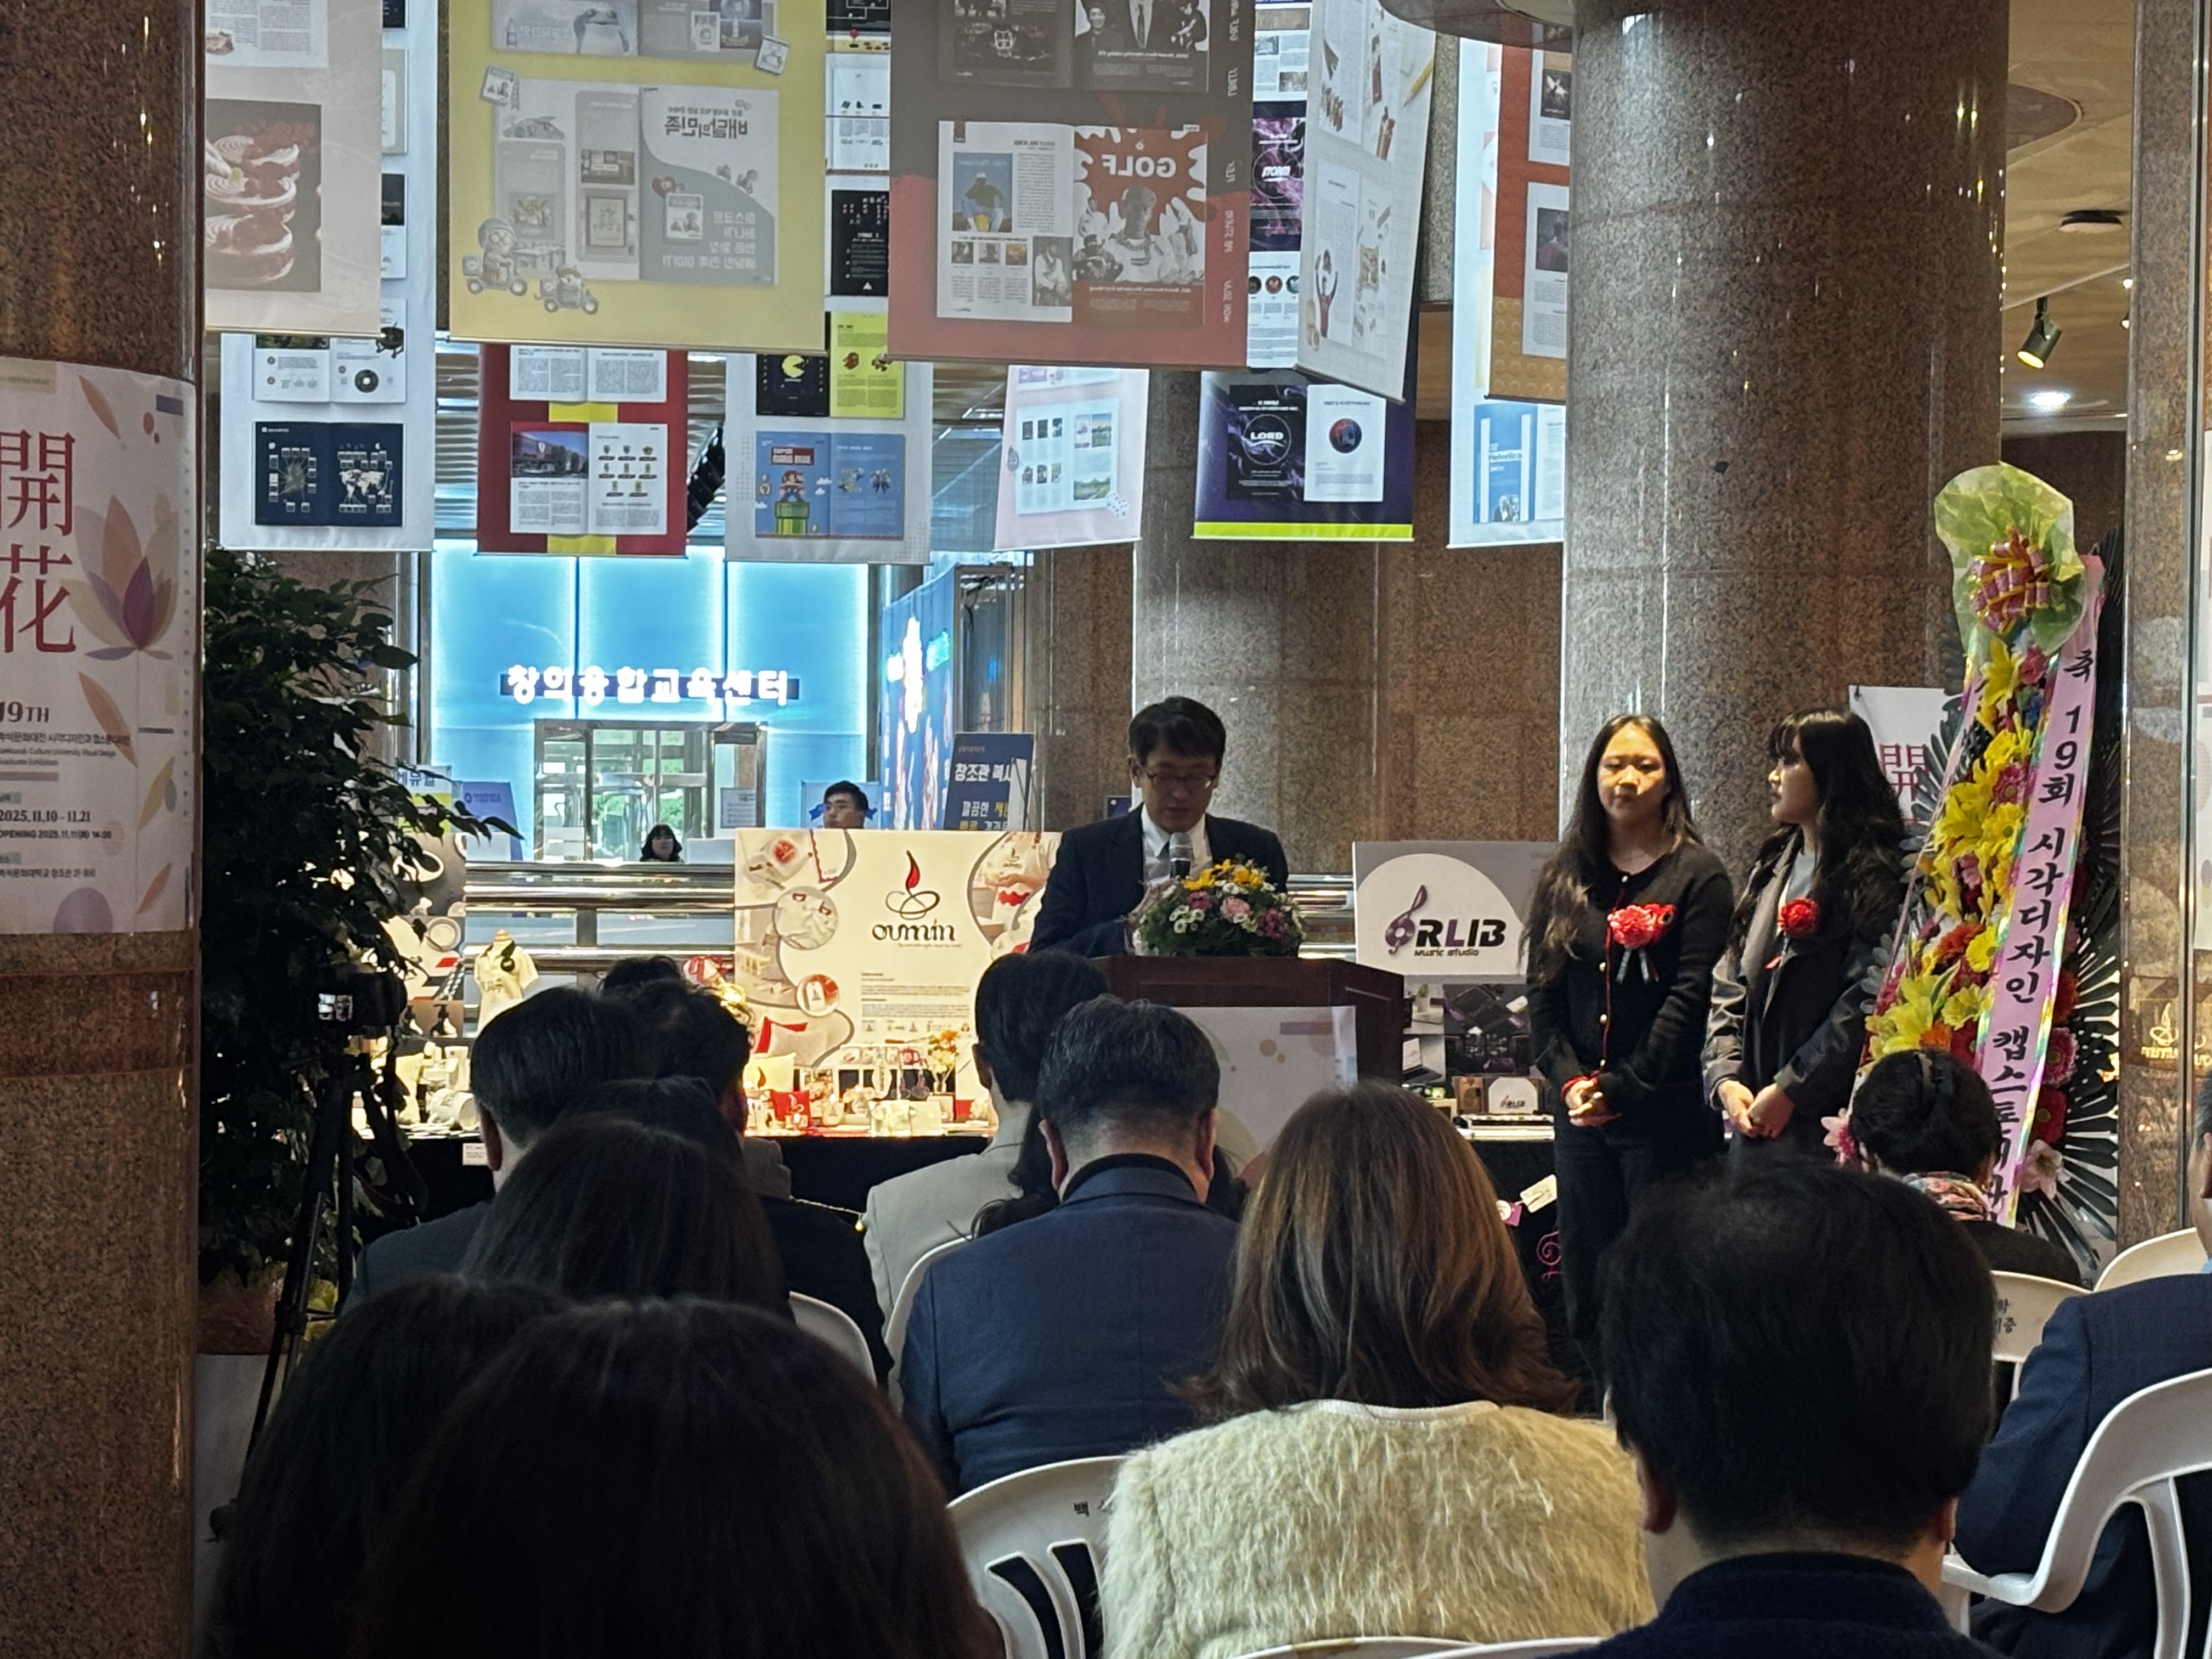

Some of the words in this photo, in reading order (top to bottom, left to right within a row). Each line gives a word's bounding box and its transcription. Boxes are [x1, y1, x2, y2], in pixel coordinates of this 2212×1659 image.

[2063, 647, 2095, 682] 축
[2038, 706, 2081, 808] 19회
[872, 918, 956, 941] oumin
[2005, 827, 2066, 1005] 시각디자인
